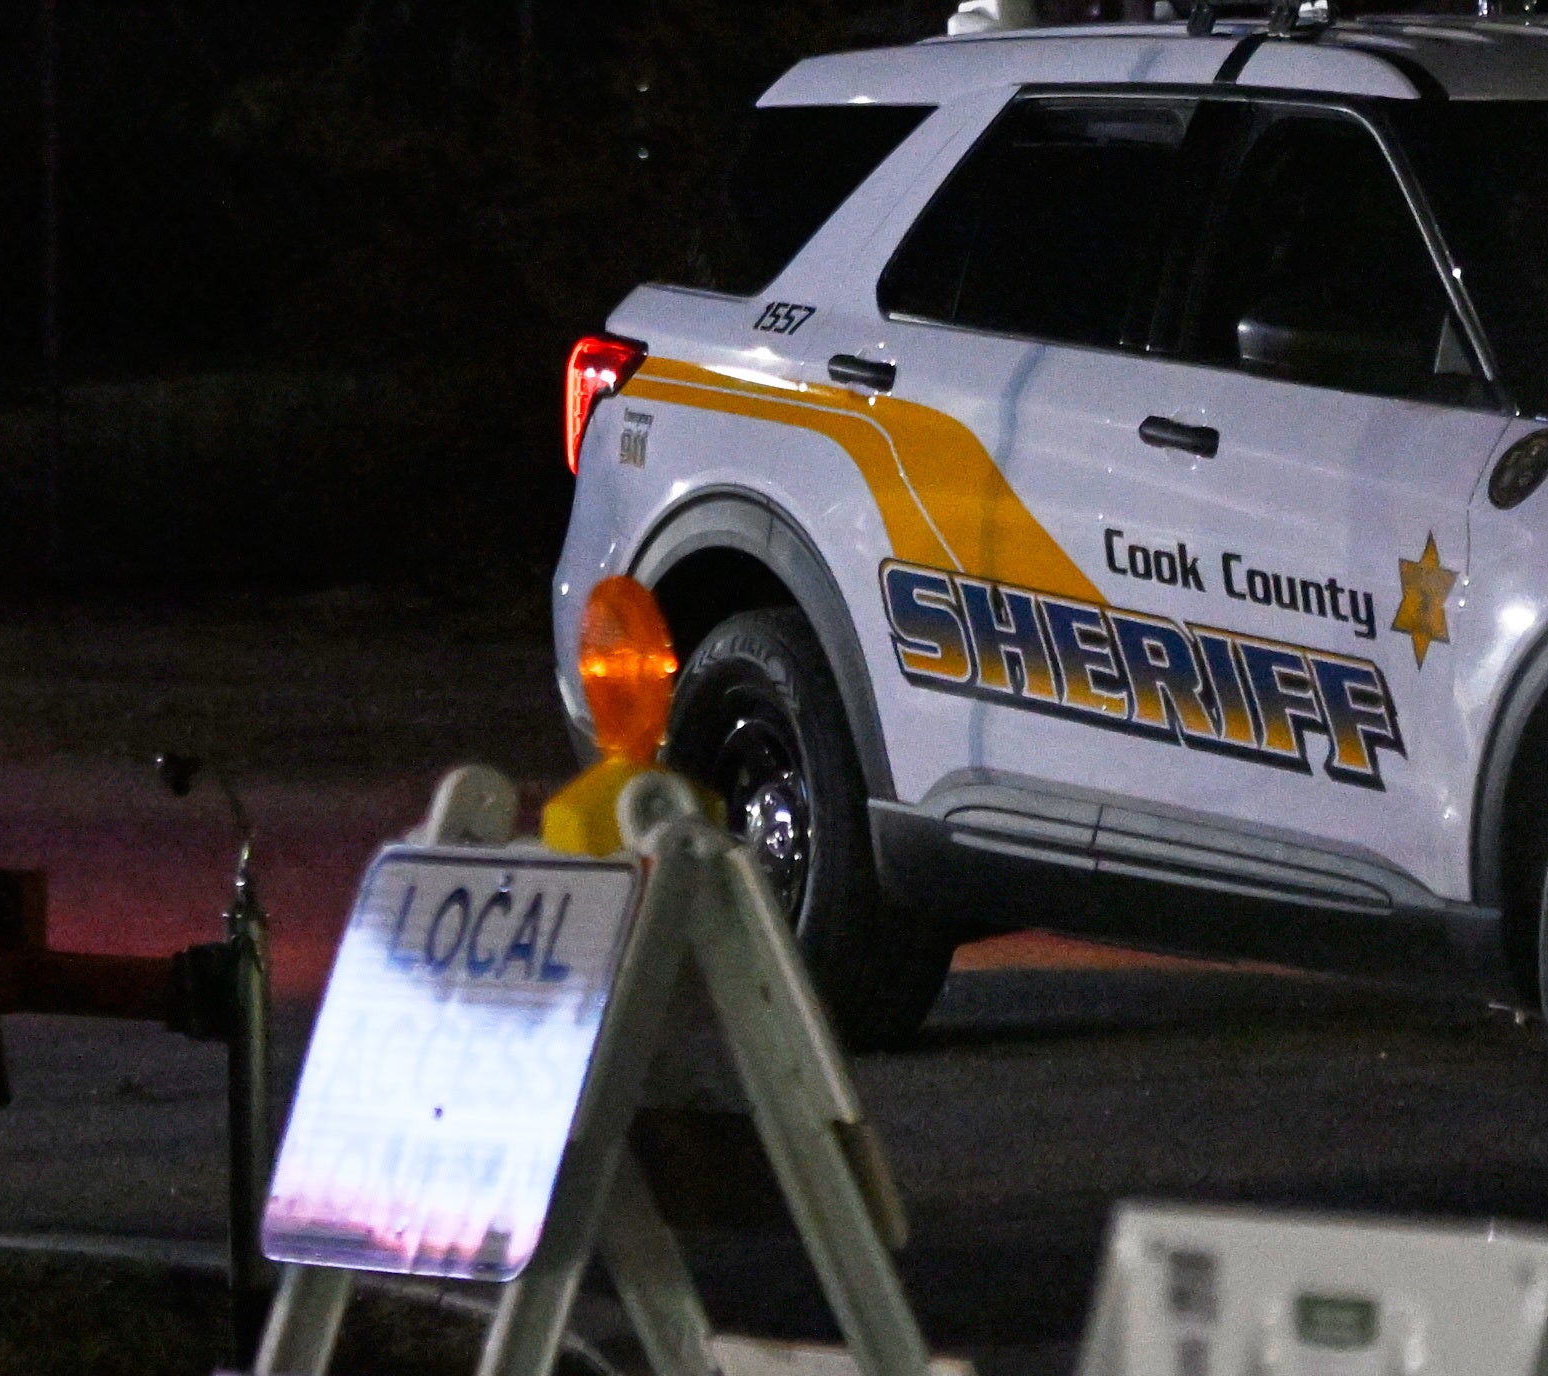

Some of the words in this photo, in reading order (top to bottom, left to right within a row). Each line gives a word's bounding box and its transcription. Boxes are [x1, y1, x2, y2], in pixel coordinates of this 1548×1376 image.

[753, 302, 816, 335] 1557
[1104, 528, 1206, 593] Cook
[1221, 552, 1377, 641] County
[877, 557, 1408, 792] SHERIFF
[385, 884, 574, 981] LOCAL
